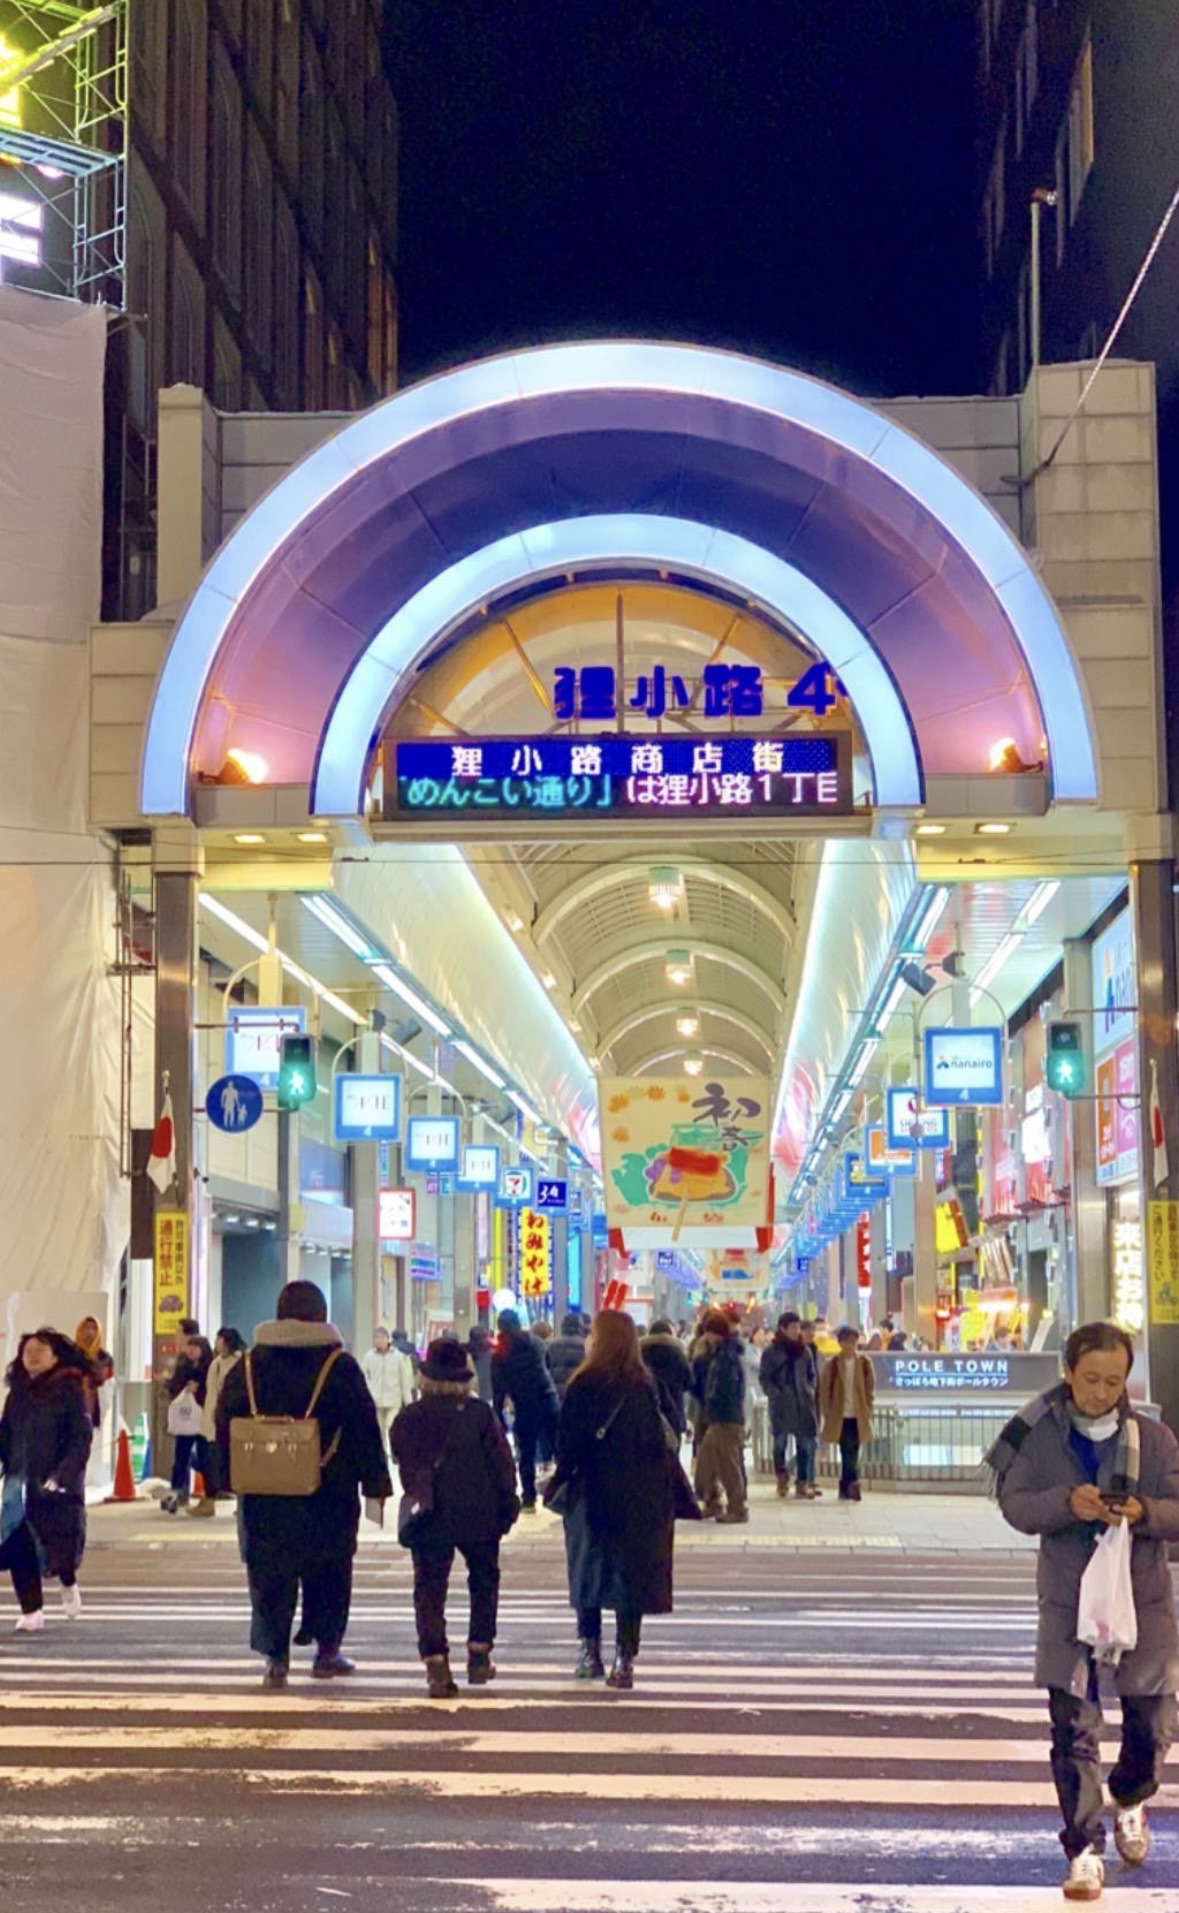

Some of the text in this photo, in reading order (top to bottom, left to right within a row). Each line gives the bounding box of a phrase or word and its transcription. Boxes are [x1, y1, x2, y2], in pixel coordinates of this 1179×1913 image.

[554, 661, 848, 719] 狸小路4
[452, 742, 784, 776] 狸小路商店街
[160, 1219, 173, 1287] 通行禁止
[896, 1360, 1008, 1372] POLE TOWN
